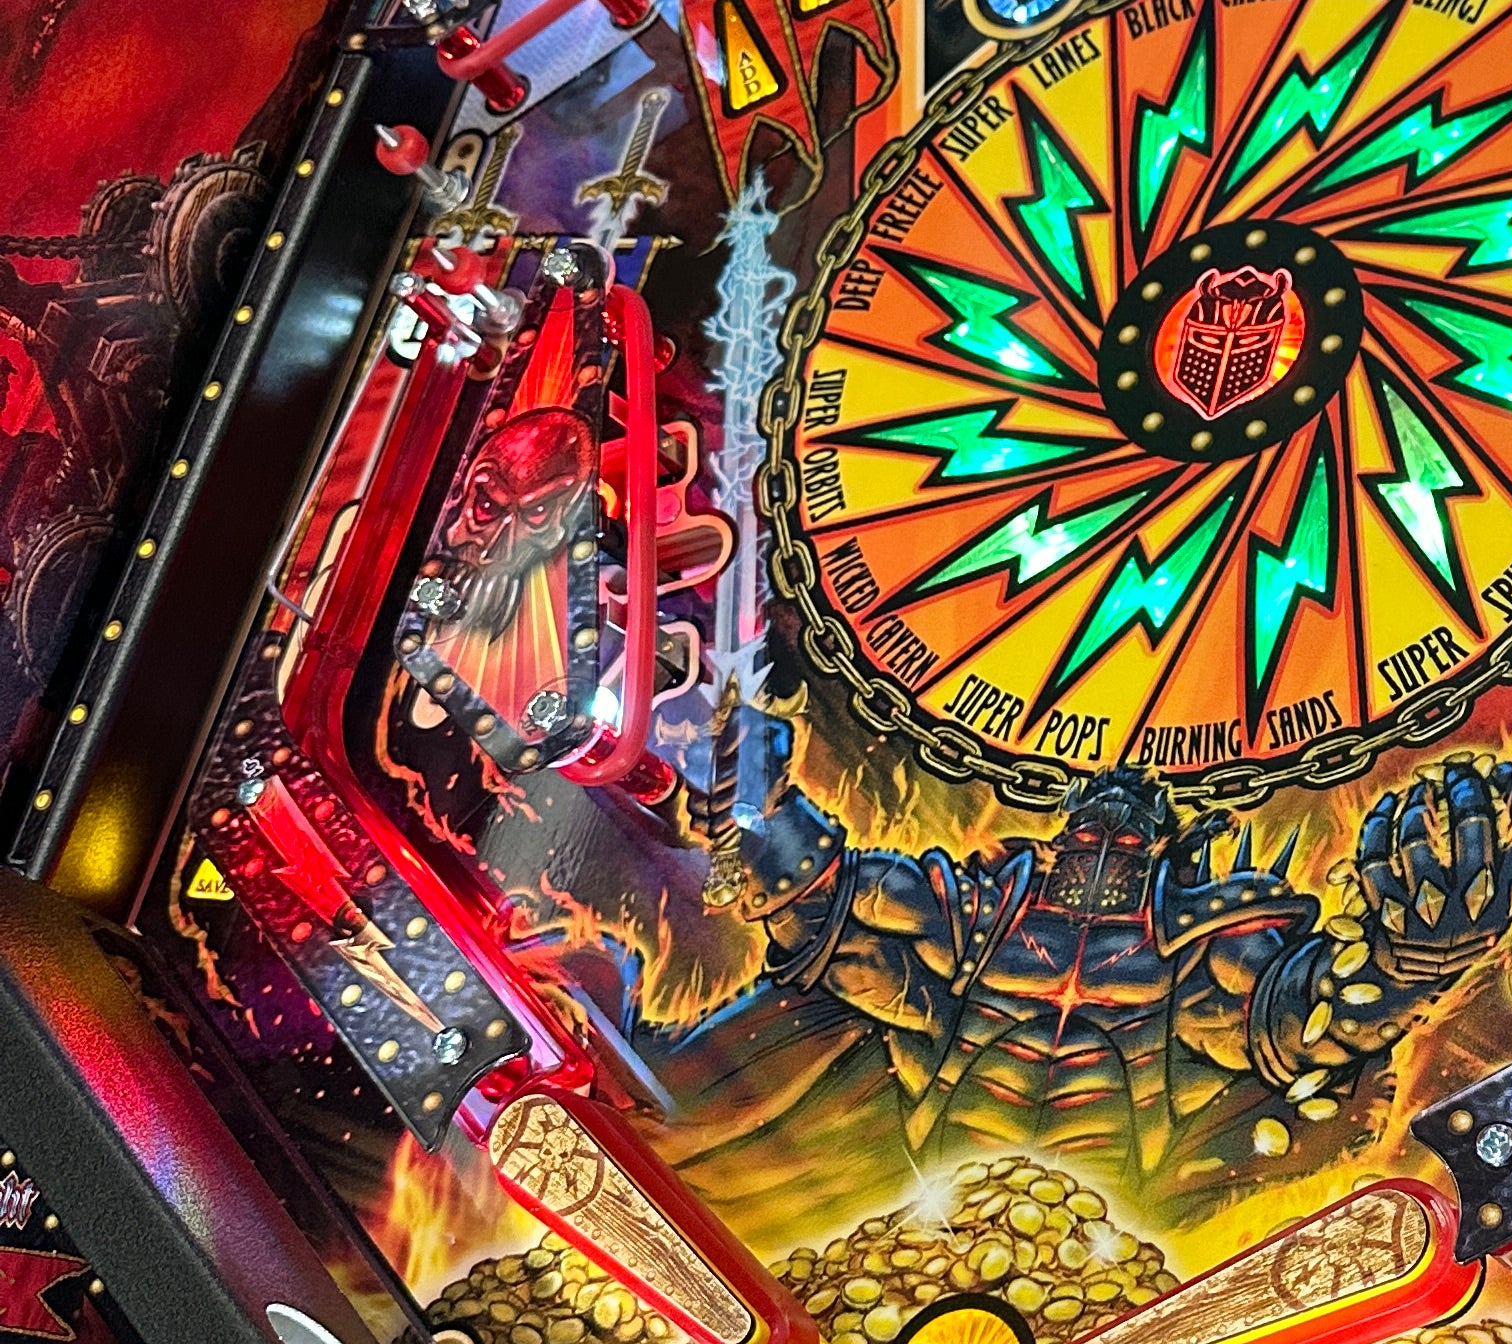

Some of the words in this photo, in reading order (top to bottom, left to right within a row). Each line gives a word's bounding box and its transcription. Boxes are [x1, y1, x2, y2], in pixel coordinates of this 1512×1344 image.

[738, 50, 763, 96] ADD
[938, 95, 1014, 162] SUPER
[1029, 28, 1102, 90] LANES
[834, 257, 887, 312] DEEP
[871, 168, 945, 243] FREEZE
[803, 368, 848, 431] SUPER
[803, 447, 847, 523] ORBITS
[821, 536, 882, 613] WICKED
[865, 614, 941, 688] CAVERN
[1376, 624, 1471, 702] SUPER
[943, 673, 1027, 742] SUPER
[1041, 709, 1111, 762] POPS
[1138, 719, 1242, 767] BURNING
[1265, 690, 1343, 750] SANDS
